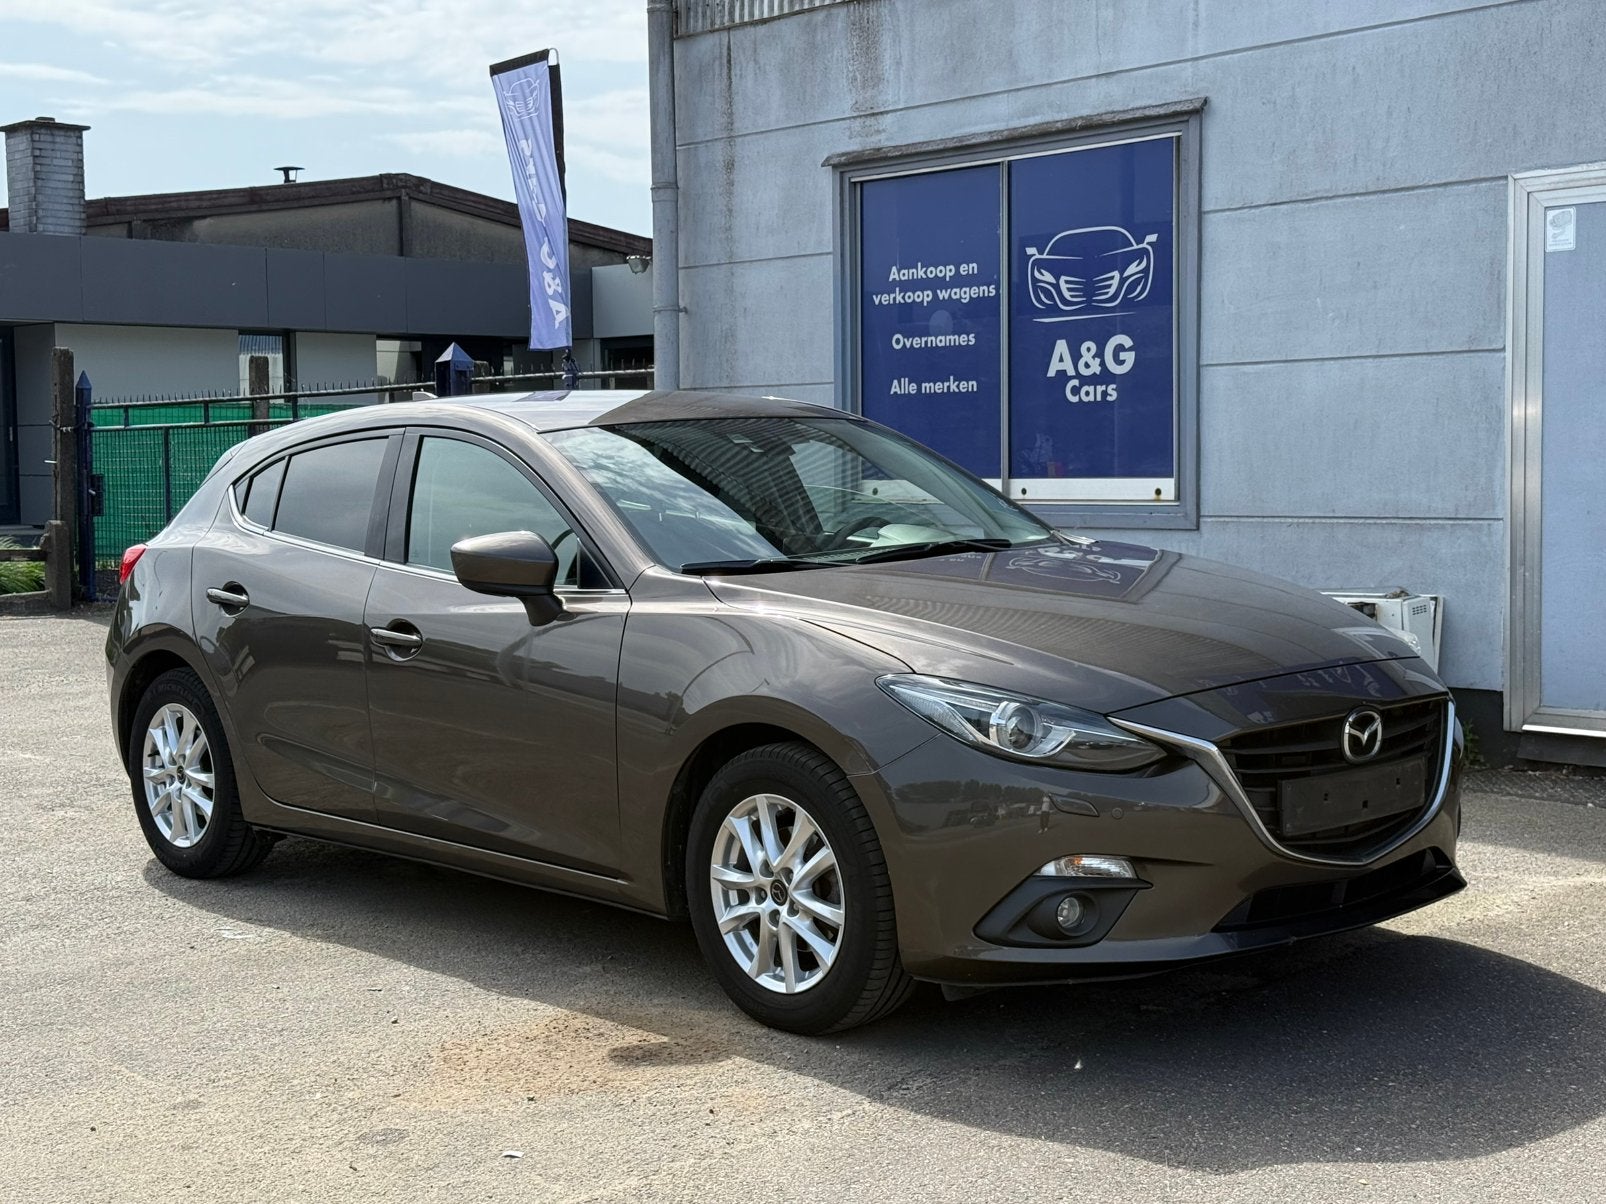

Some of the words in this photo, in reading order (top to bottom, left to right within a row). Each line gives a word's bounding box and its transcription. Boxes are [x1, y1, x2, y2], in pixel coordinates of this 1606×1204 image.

[889, 262, 955, 282] Aankoop
[959, 263, 978, 275] en
[872, 288, 933, 306] verkoop
[937, 285, 996, 304] wagens
[892, 333, 976, 350] Overnames
[1047, 334, 1136, 377] A&G
[890, 378, 918, 395] Alle
[921, 376, 978, 394] merken
[1065, 379, 1118, 403] Cars
